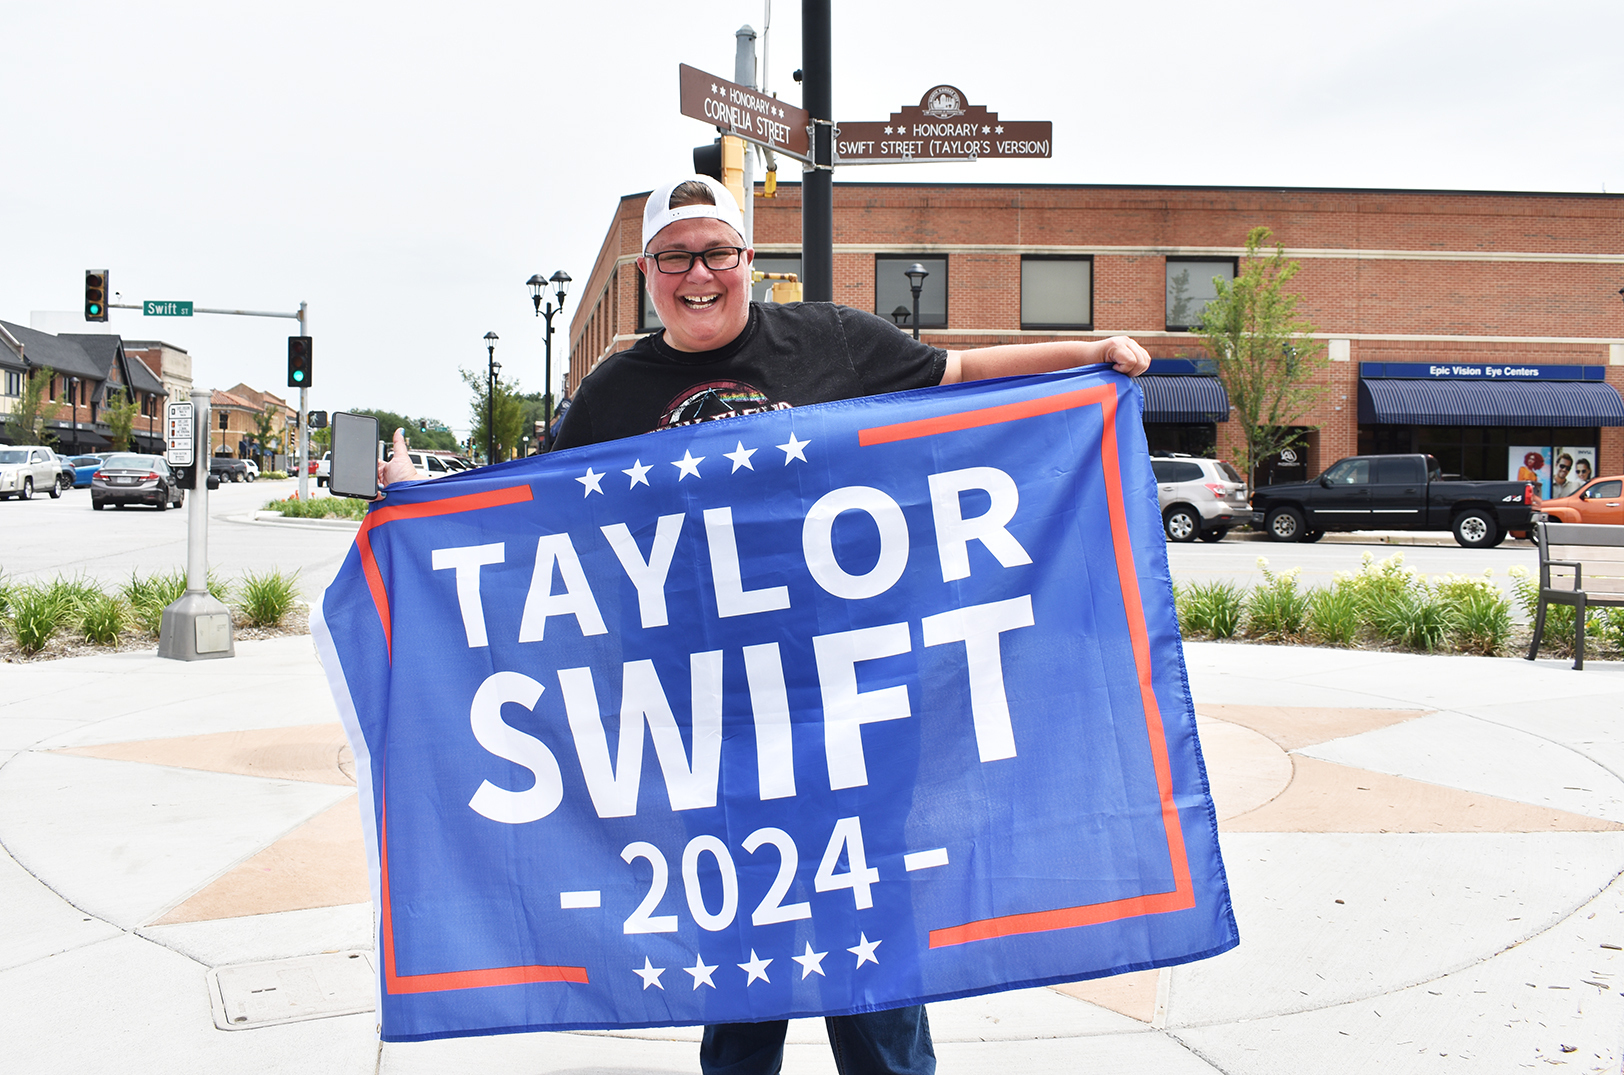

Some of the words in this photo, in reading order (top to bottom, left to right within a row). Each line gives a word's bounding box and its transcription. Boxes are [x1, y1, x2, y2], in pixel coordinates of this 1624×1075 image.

[729, 88, 770, 115] HONORARY
[704, 97, 752, 132] CORNELIA
[756, 116, 791, 144] STREET
[913, 123, 978, 137] HONORARY
[839, 141, 874, 154] SWIFT
[880, 141, 924, 154] STREET
[929, 140, 991, 156] (TAYLOR'S
[996, 140, 1050, 156] VERSION)
[147, 302, 177, 315] Swift
[1429, 366, 1451, 377] Epic
[1452, 366, 1482, 375] Vision
[1485, 367, 1502, 377] Eye
[1504, 367, 1539, 376] Centers
[431, 467, 1033, 648] TAYLOR
[468, 594, 1035, 824] SWIFT
